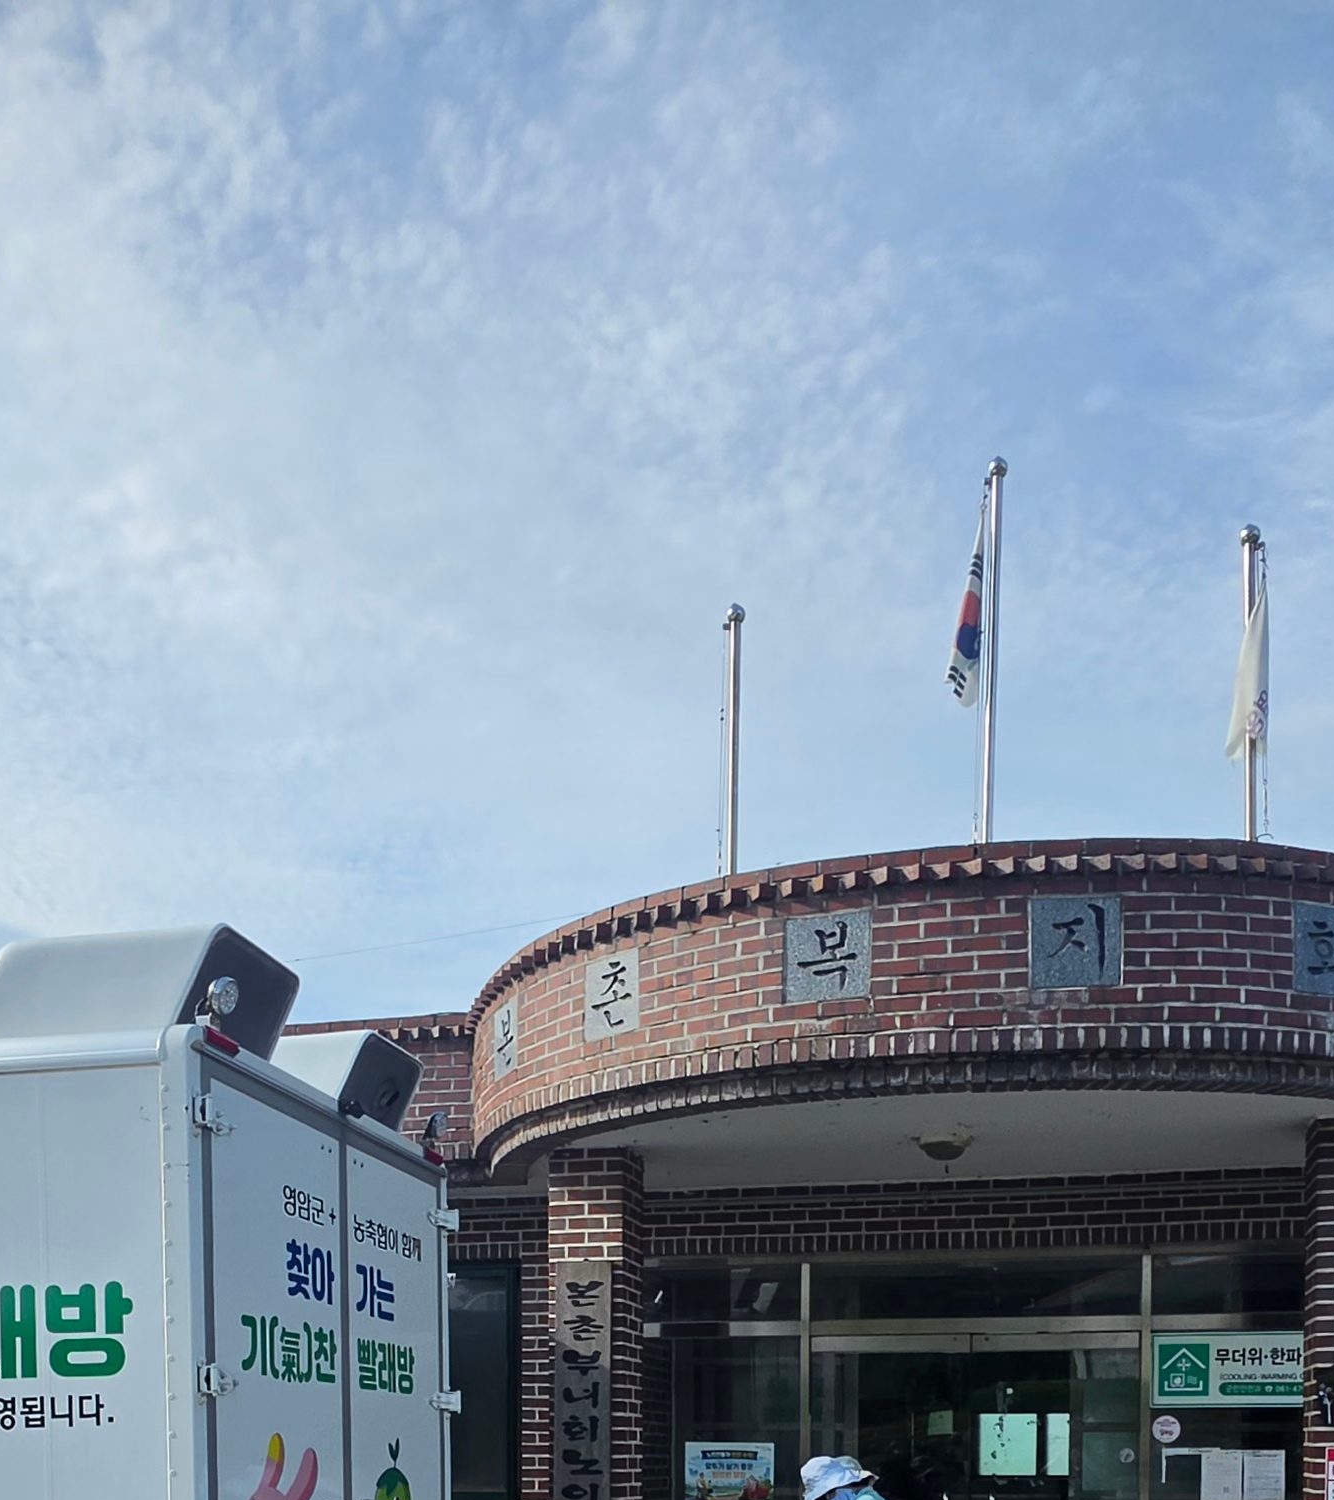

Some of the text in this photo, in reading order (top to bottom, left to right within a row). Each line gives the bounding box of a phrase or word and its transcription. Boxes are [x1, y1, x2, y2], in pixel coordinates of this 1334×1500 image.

[283, 1185, 324, 1226] 영암군
[353, 1213, 399, 1254] 농축협이
[357, 1337, 415, 1395] 빨래방
[1215, 1346, 1303, 1367] 무더위·한파
